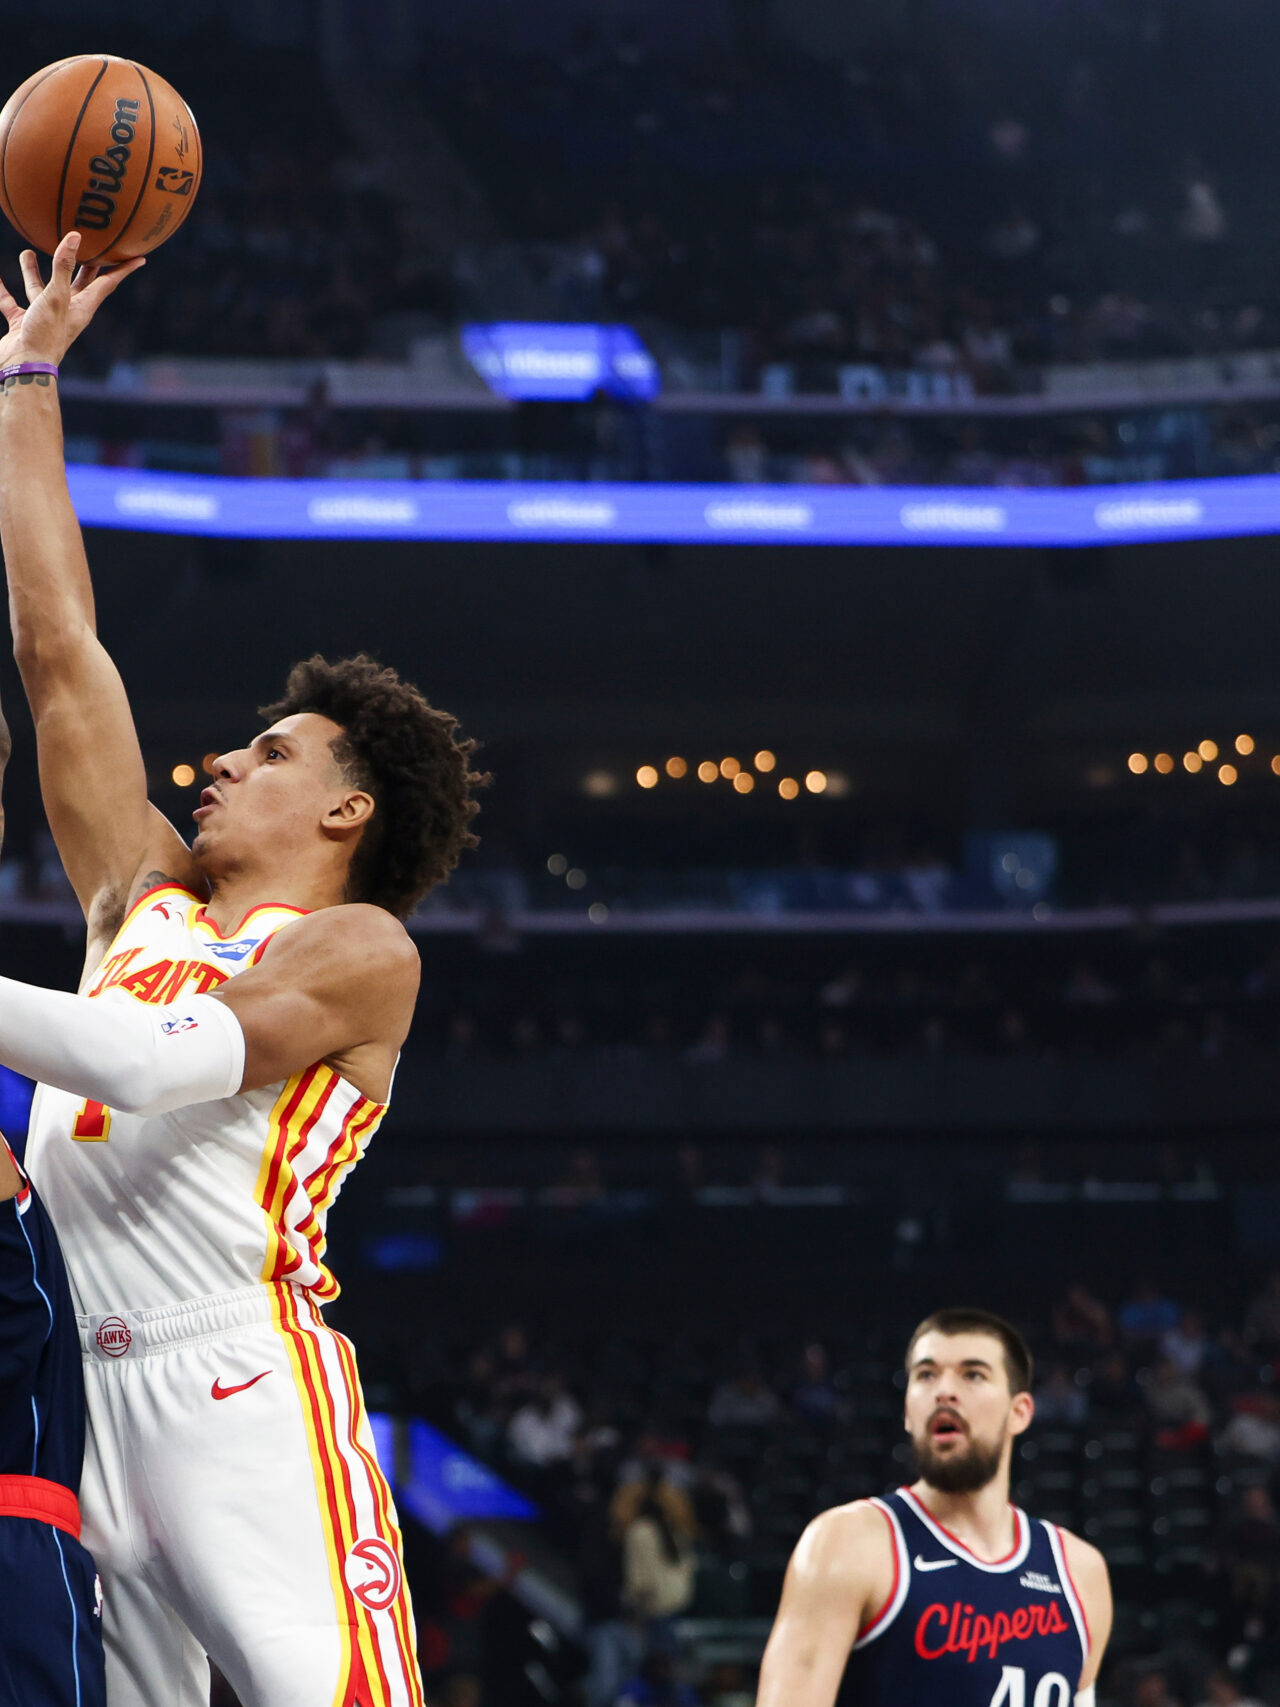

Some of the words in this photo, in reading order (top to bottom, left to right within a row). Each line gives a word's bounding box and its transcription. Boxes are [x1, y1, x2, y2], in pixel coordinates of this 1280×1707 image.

[74, 98, 139, 230] Wilson
[95, 1329, 133, 1345] HAWKS
[914, 1601, 1068, 1663] Clippers
